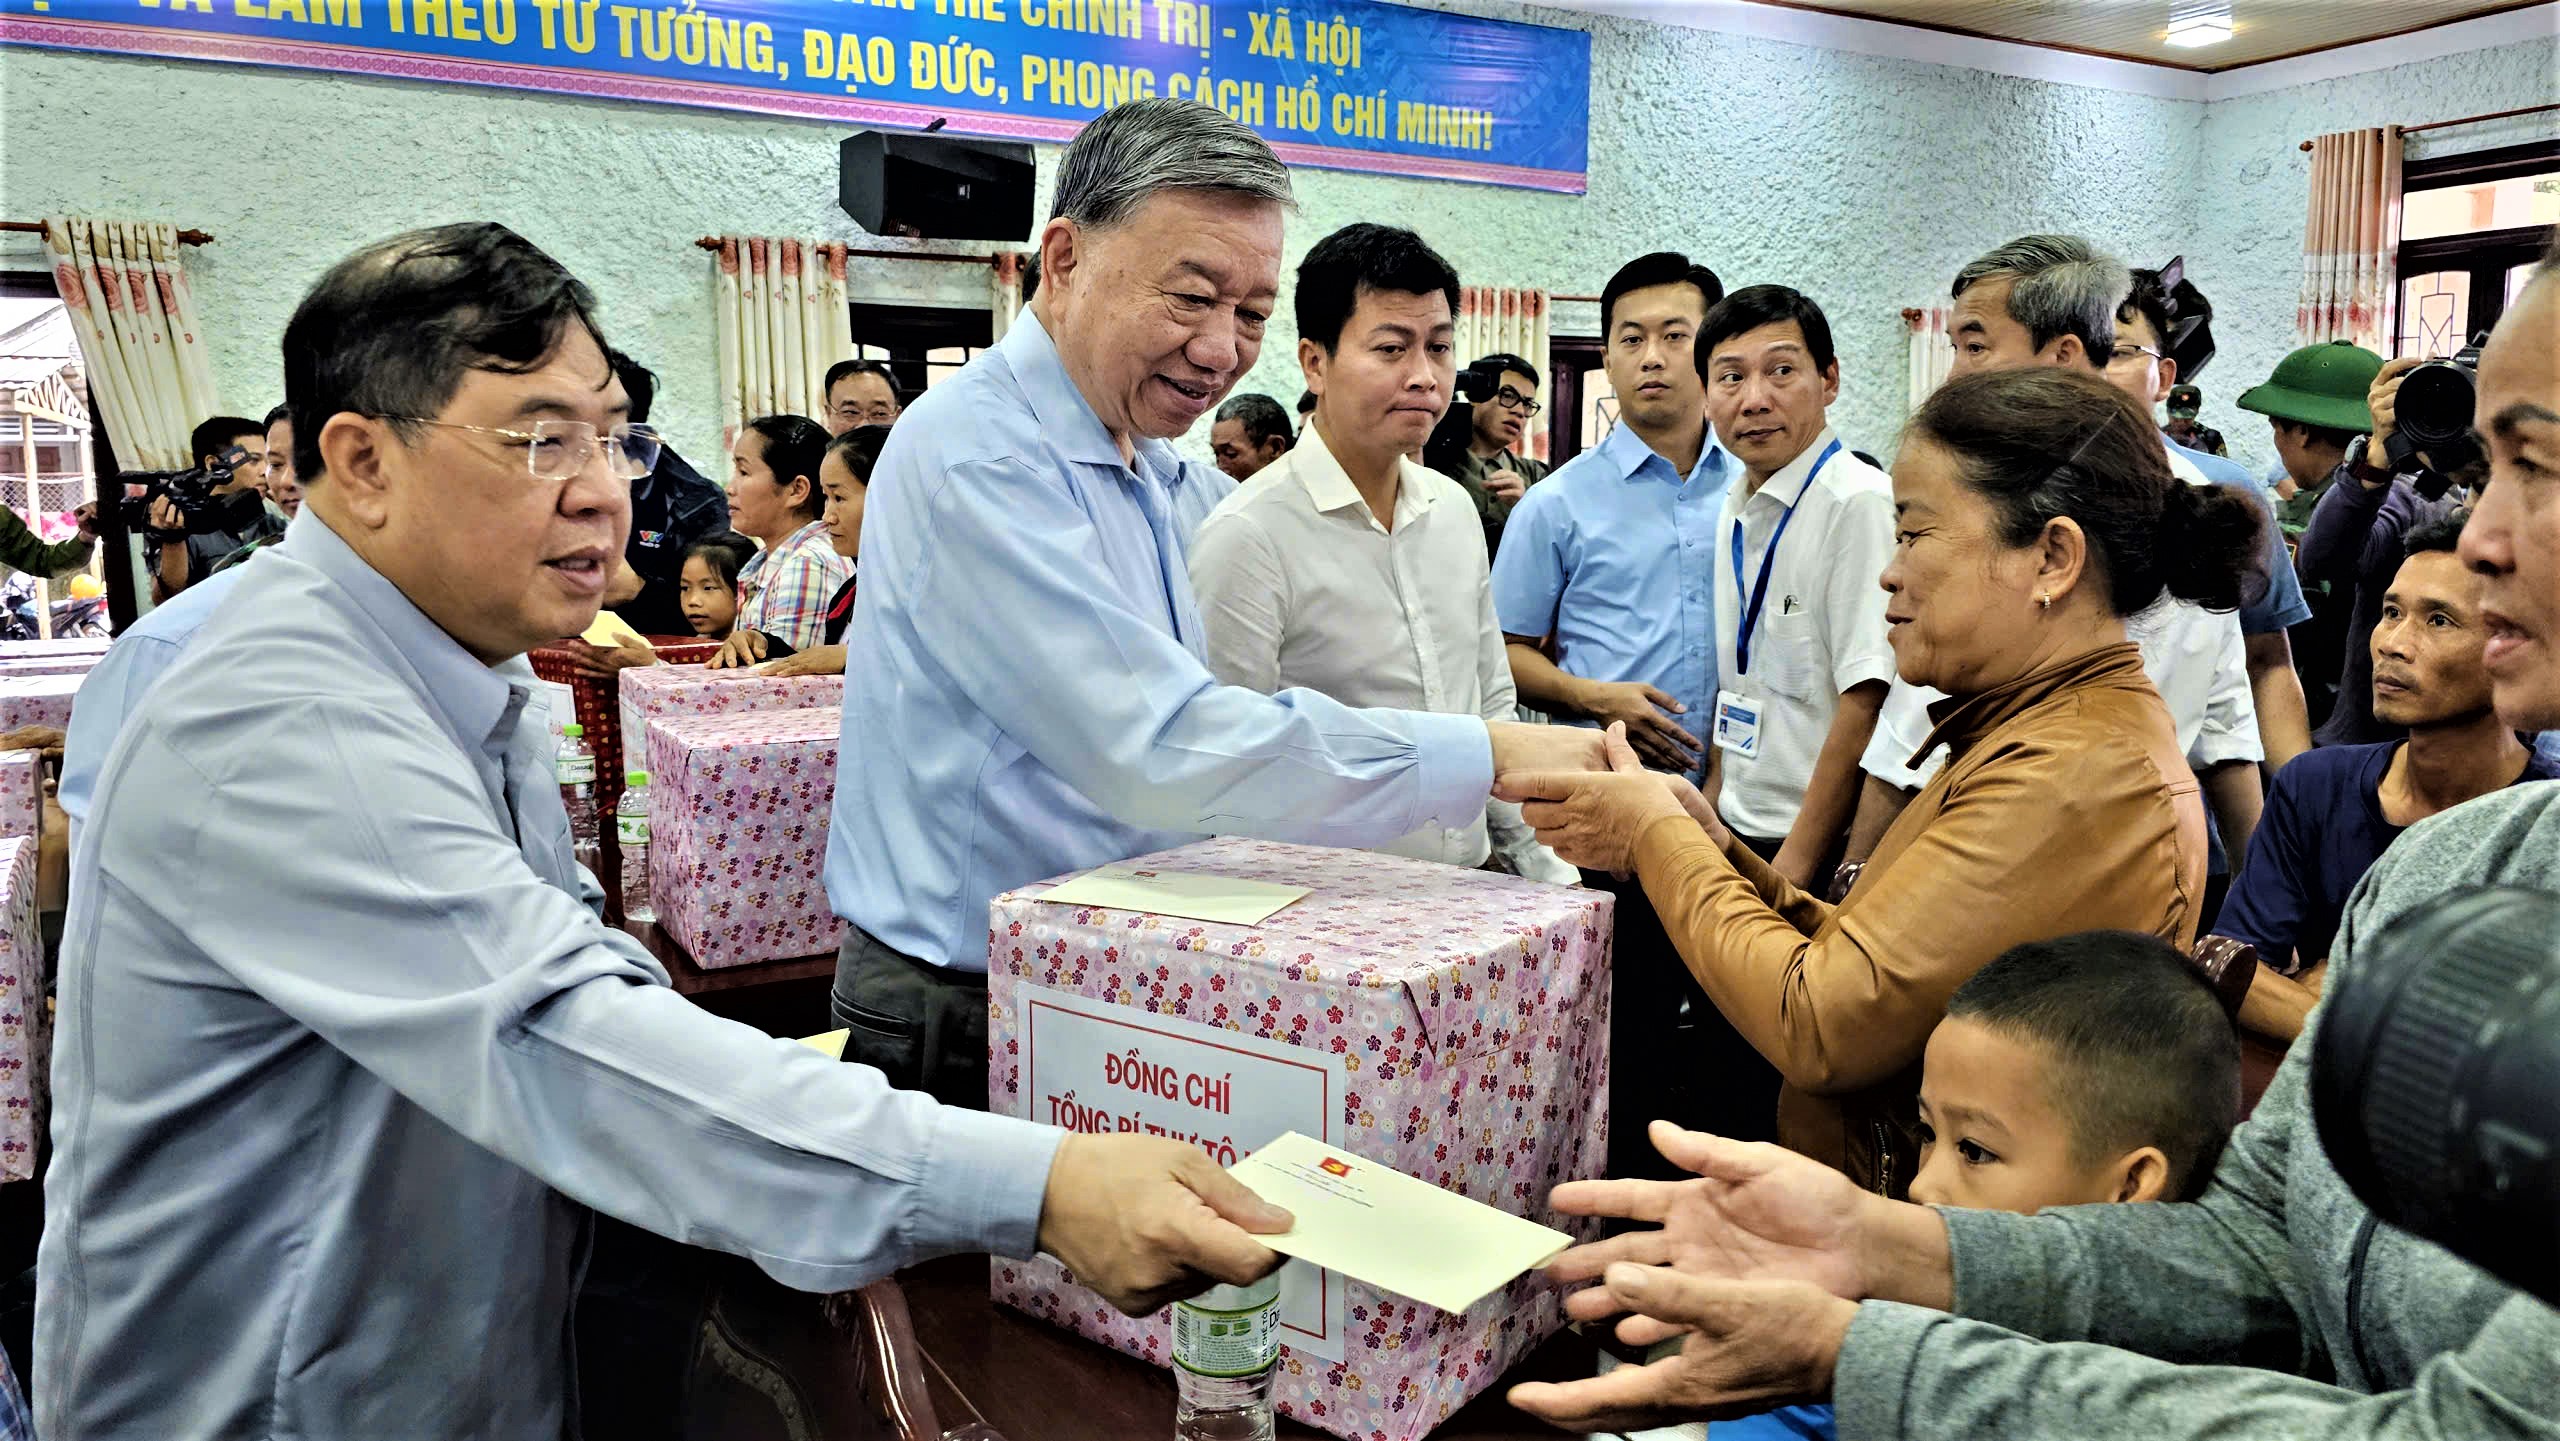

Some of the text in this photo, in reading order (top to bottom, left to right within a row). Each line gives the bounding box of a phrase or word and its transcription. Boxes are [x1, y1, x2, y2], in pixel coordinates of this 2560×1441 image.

[387, 0, 517, 45] THEO
[611, 0, 789, 81] TƯỞNG,
[803, 28, 895, 93] ĐẠO
[909, 36, 1009, 104] ĐỨC,
[1021, 54, 1155, 110] PHONG
[1276, 74, 1321, 132] HỒ
[1332, 89, 1387, 139] CHÍ
[1397, 101, 1493, 150] MINH!
[1152, 0, 1210, 58] TRỊ
[1223, 28, 1236, 38] -
[1248, 8, 1294, 59] XÃ
[1306, 15, 1361, 76] HỘI
[1105, 1048, 1231, 1114] ĐỒNG CHÍ
